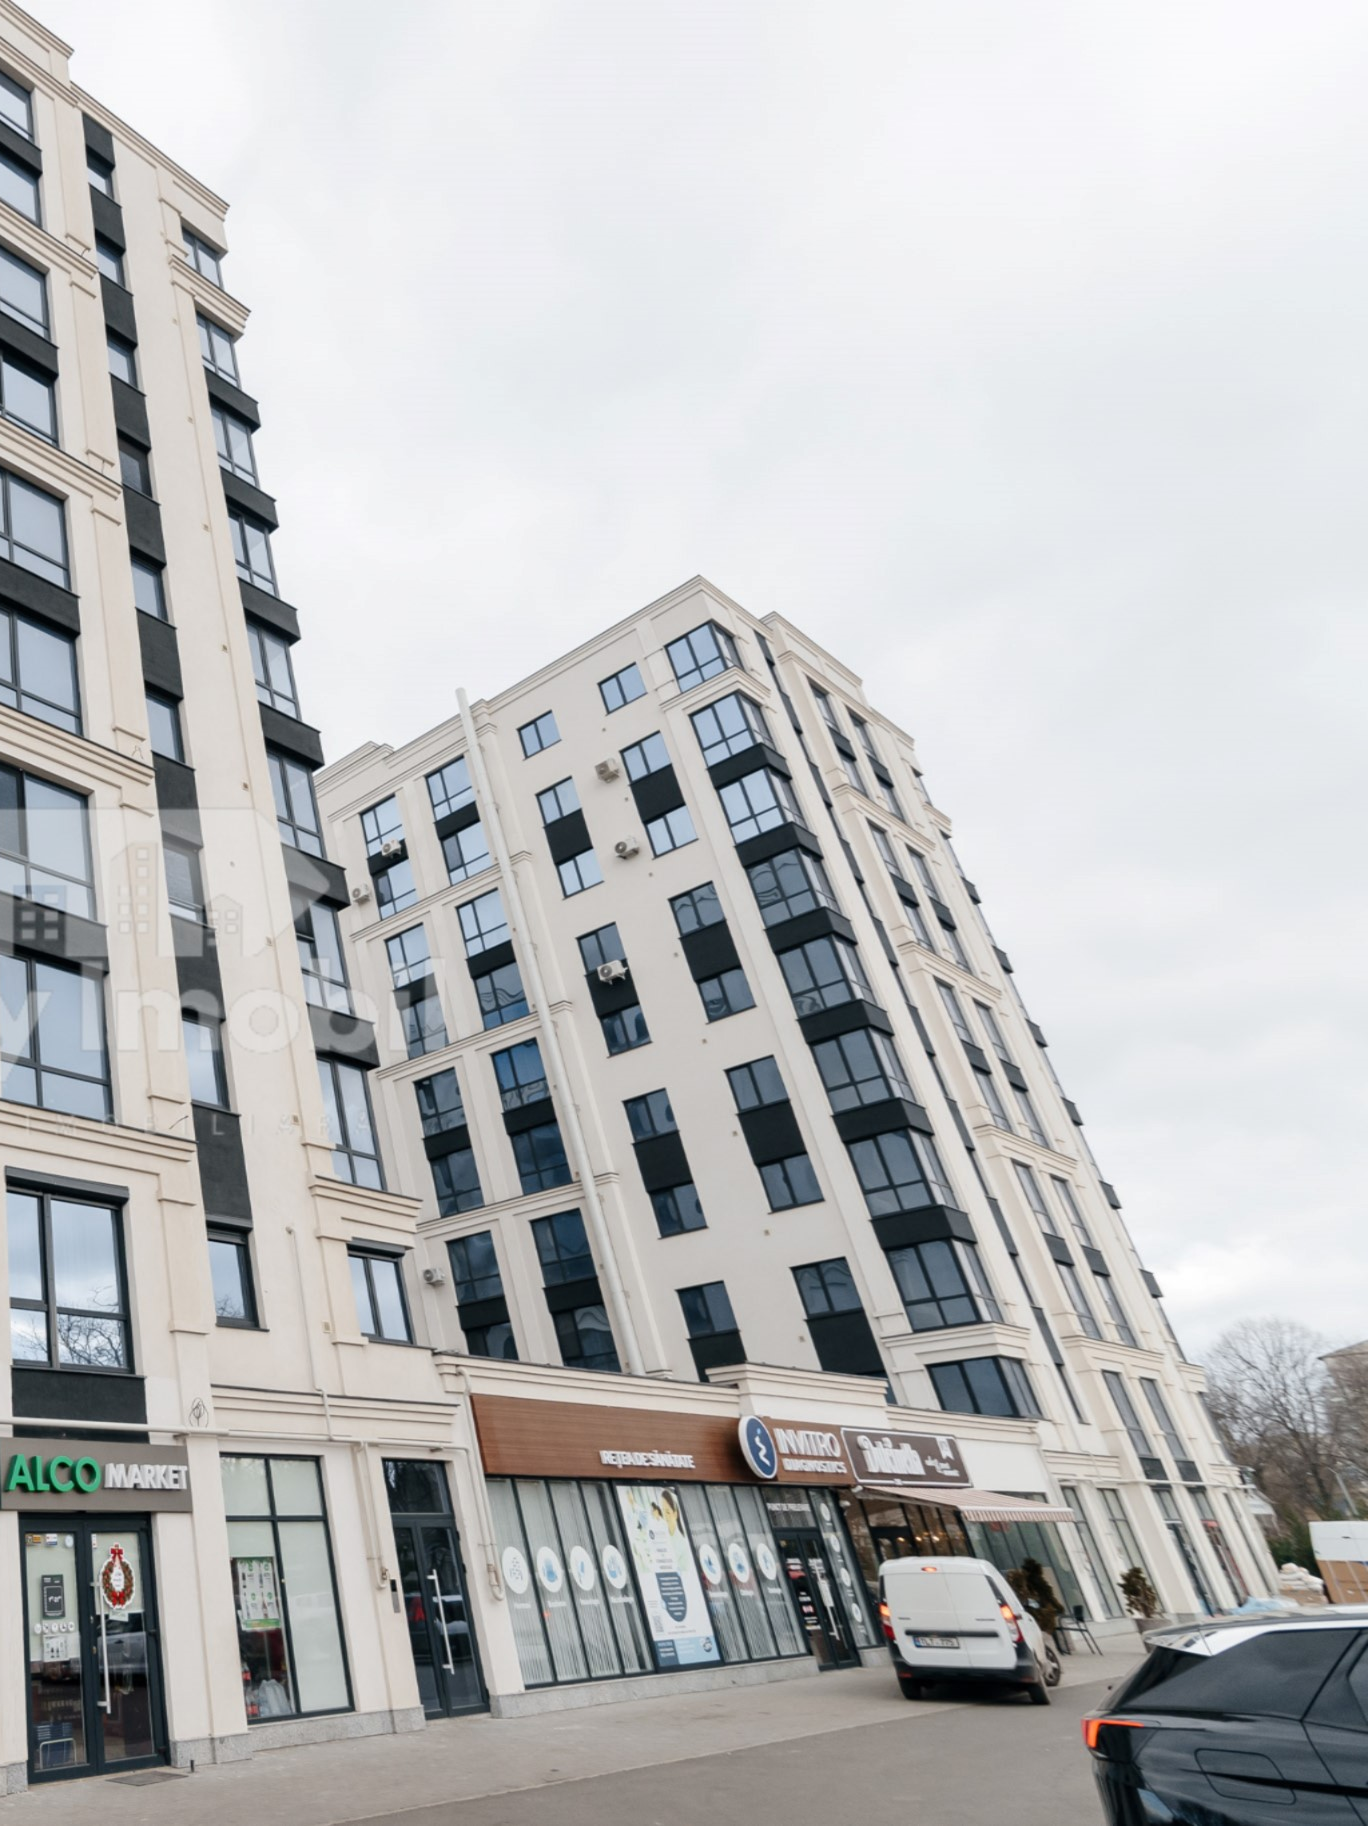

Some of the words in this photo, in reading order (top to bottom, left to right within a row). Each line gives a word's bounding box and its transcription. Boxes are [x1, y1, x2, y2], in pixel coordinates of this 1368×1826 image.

[773, 1427, 841, 1458] INVITRO
[5, 1452, 102, 1494] ALCO
[104, 1463, 188, 1491] MARKET
[782, 1458, 848, 1475] DIAGNOSTICS
